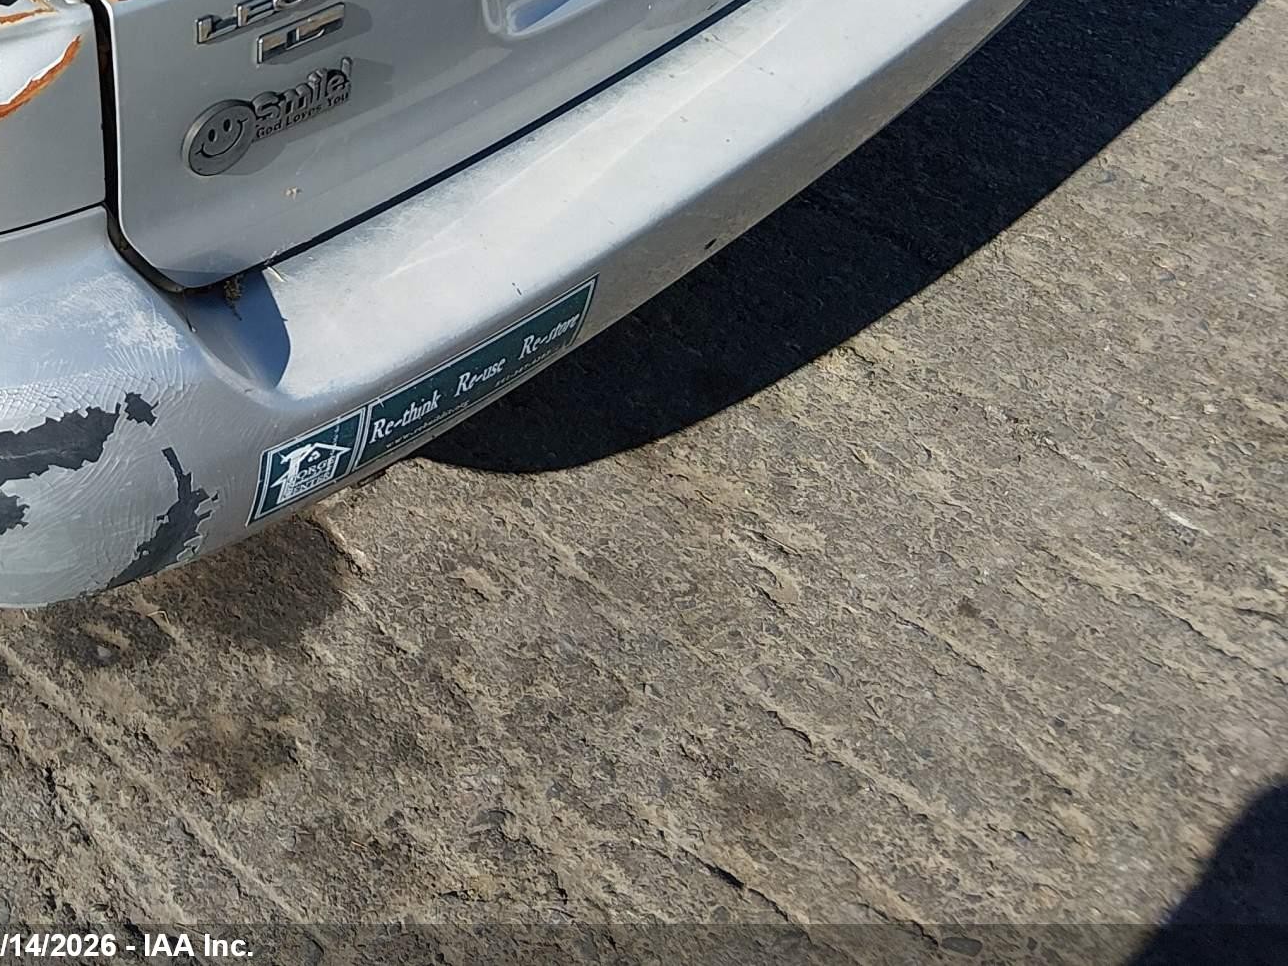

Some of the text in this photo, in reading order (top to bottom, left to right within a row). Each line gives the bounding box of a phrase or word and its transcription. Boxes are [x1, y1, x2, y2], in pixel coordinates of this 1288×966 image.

[252, 55, 353, 121] Smile!
[256, 91, 349, 139] God Loves You
[368, 389, 442, 444] Re-think
[454, 355, 506, 398] Re-use
[518, 312, 580, 360] Re-store
